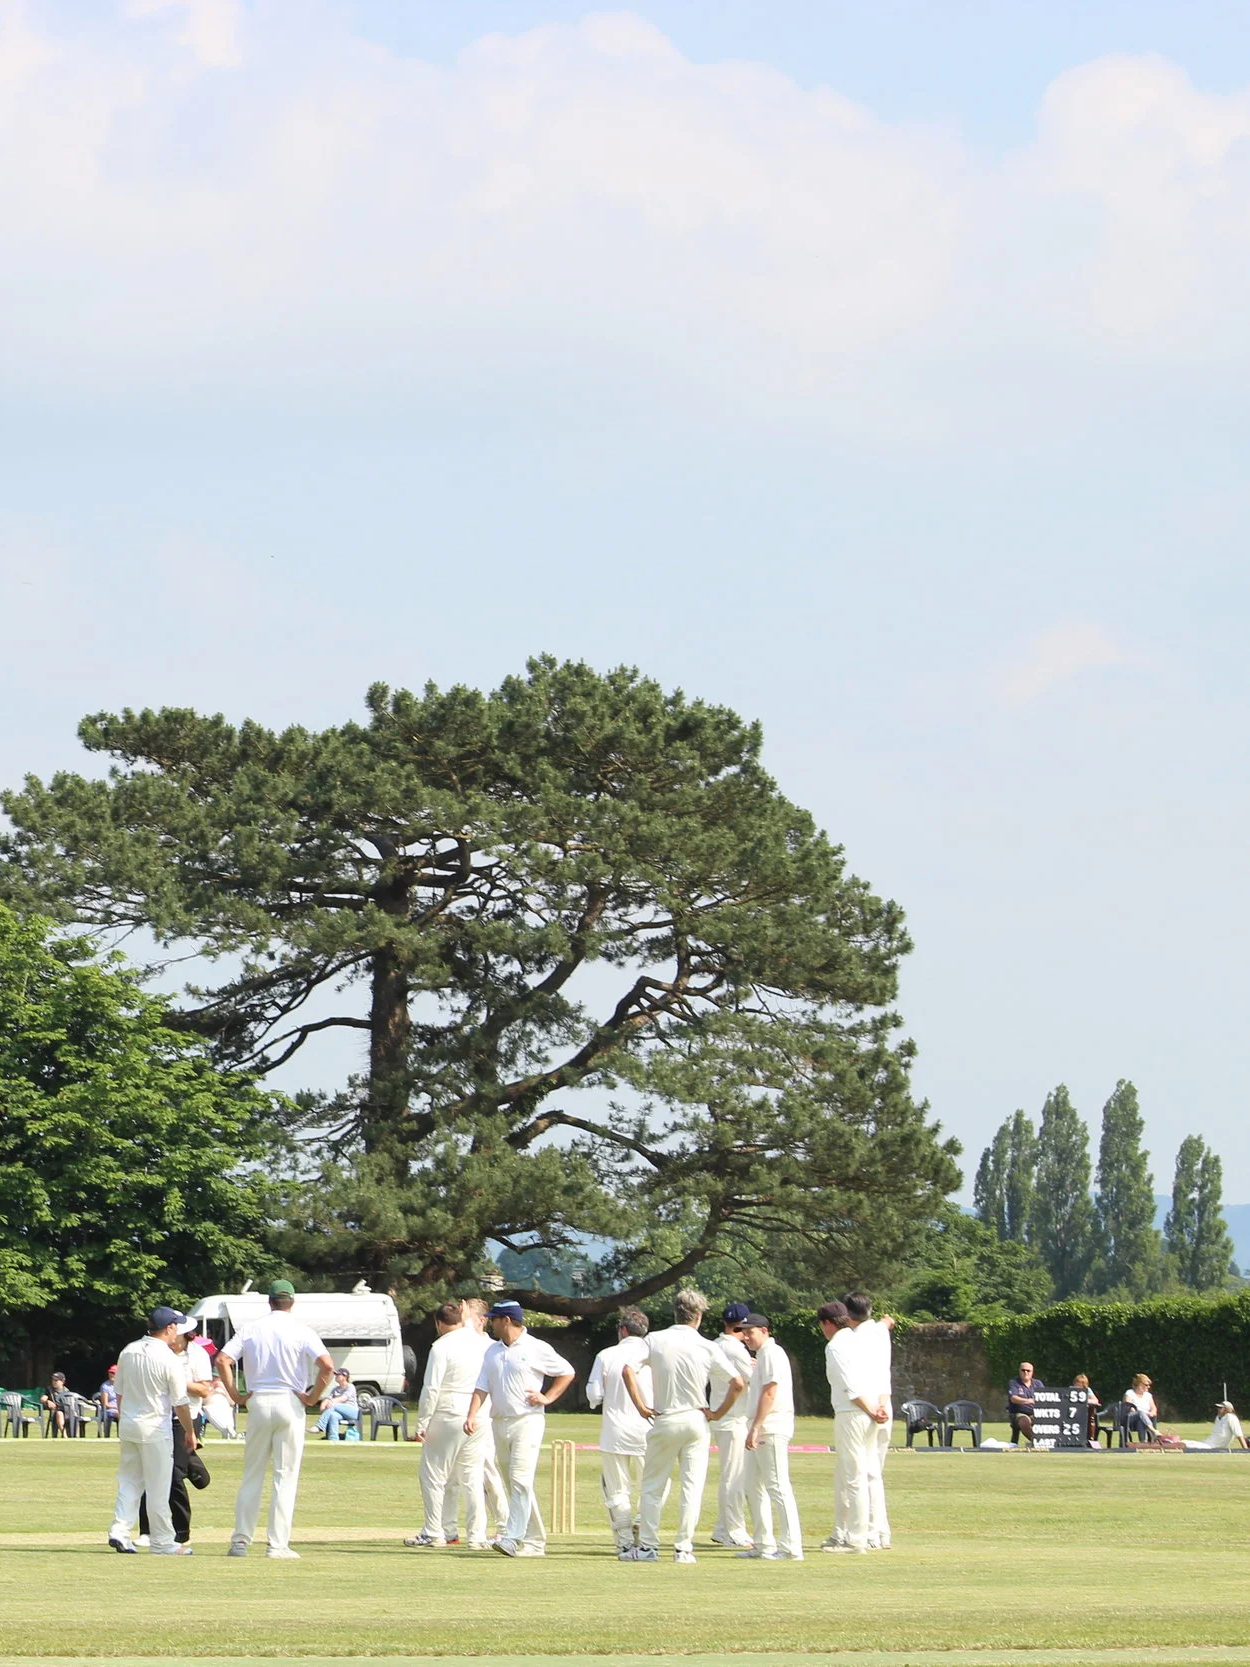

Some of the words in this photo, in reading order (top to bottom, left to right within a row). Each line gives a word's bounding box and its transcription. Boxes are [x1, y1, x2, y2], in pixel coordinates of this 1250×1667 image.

[1033, 1392, 1061, 1402] TOTAL
[1069, 1391, 1087, 1402] 59
[1033, 1408, 1061, 1418] WKTS
[1068, 1407, 1078, 1418] 7
[1032, 1424, 1060, 1434] OVERS
[1062, 1422, 1080, 1435] 25
[1033, 1438, 1056, 1448] LAST
